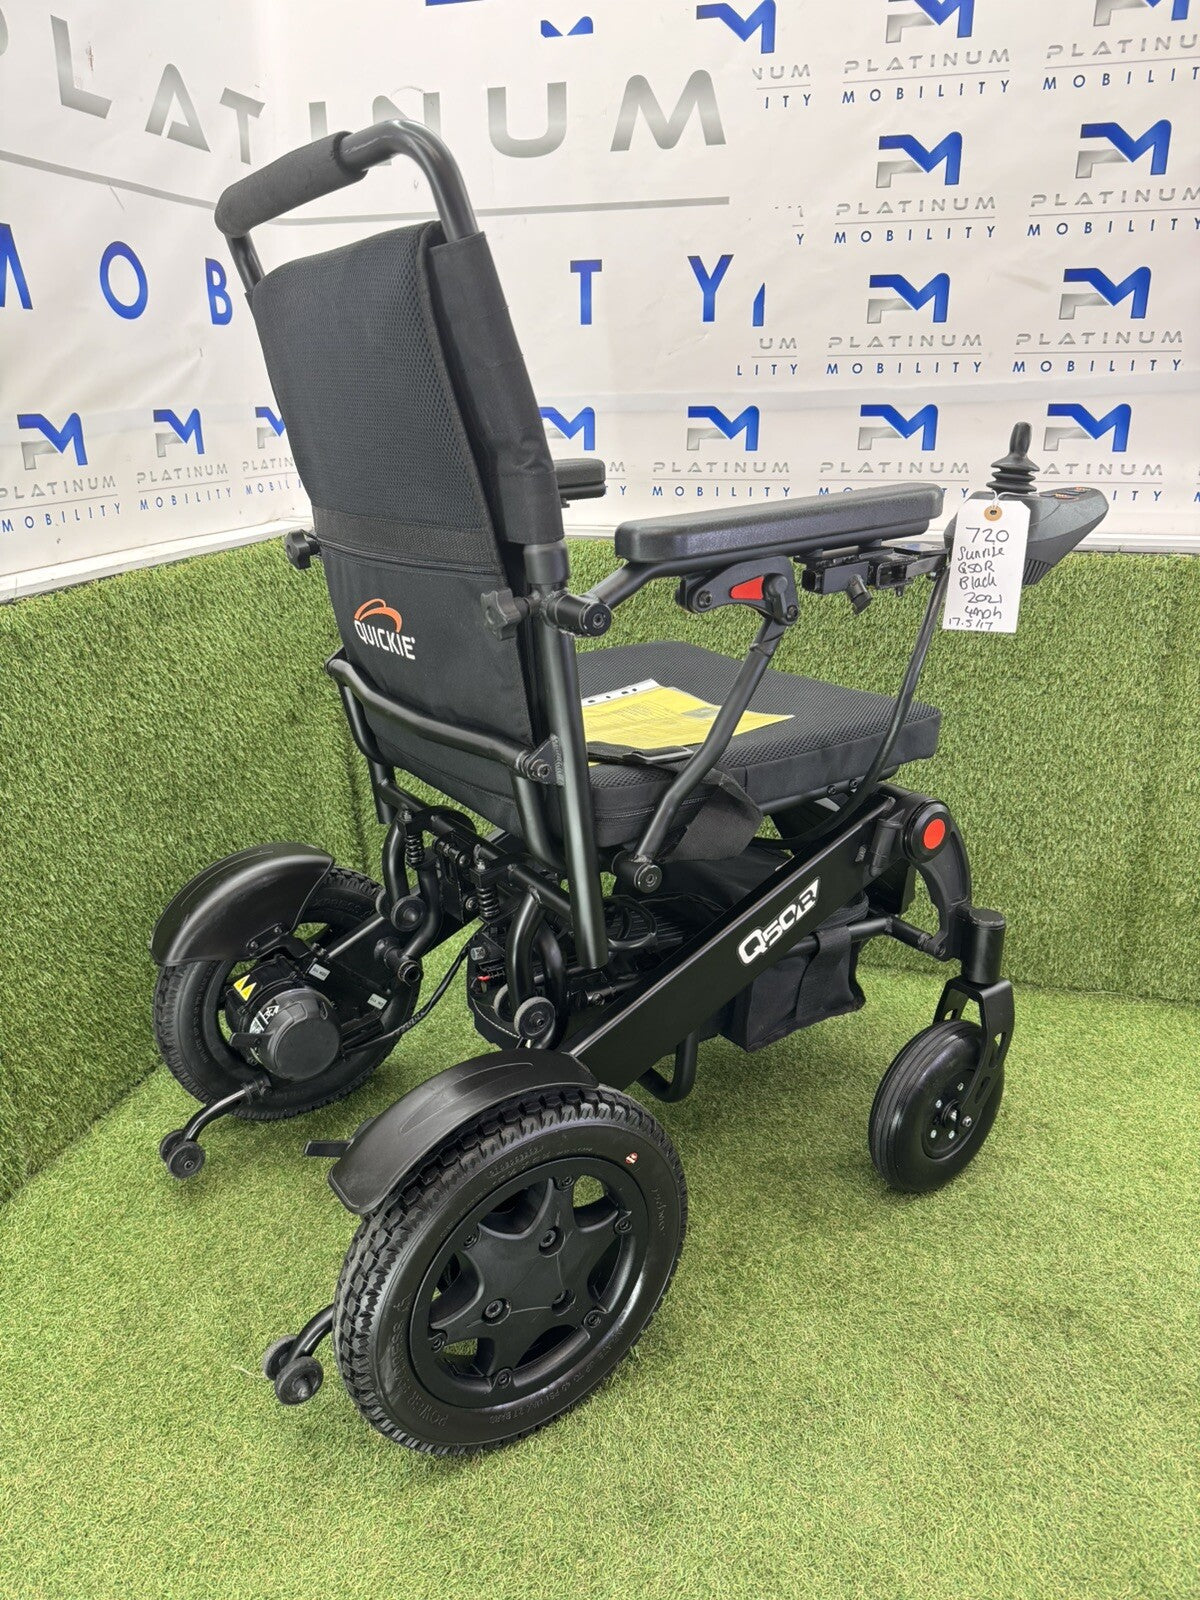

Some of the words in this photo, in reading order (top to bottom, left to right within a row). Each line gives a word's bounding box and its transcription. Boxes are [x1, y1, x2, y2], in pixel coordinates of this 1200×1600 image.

[844, 49, 1010, 74] PLATINUM
[842, 80, 1010, 104] MOBILITY
[836, 196, 995, 216] PLATINUM
[1031, 187, 1200, 207] PLATINUM
[834, 225, 995, 244] MOBILITY
[828, 334, 982, 348] PLATINUM
[1016, 331, 1182, 345] PLATINUM
[826, 362, 982, 374] MOBILITY
[1012, 359, 1181, 372] MOBILITY
[137, 464, 229, 484] PLATINUM
[653, 462, 789, 473] PLATINUM
[820, 462, 969, 473] PLATINUM
[0, 475, 116, 499] PLATINUM
[652, 486, 790, 497] MOBILITY
[139, 487, 232, 510] MOBILITY
[2, 503, 120, 532] MOBILITY
[966, 527, 1009, 543] 720
[959, 573, 997, 590] Black
[964, 592, 1002, 604] 2021
[354, 619, 415, 660] QUICKIE
